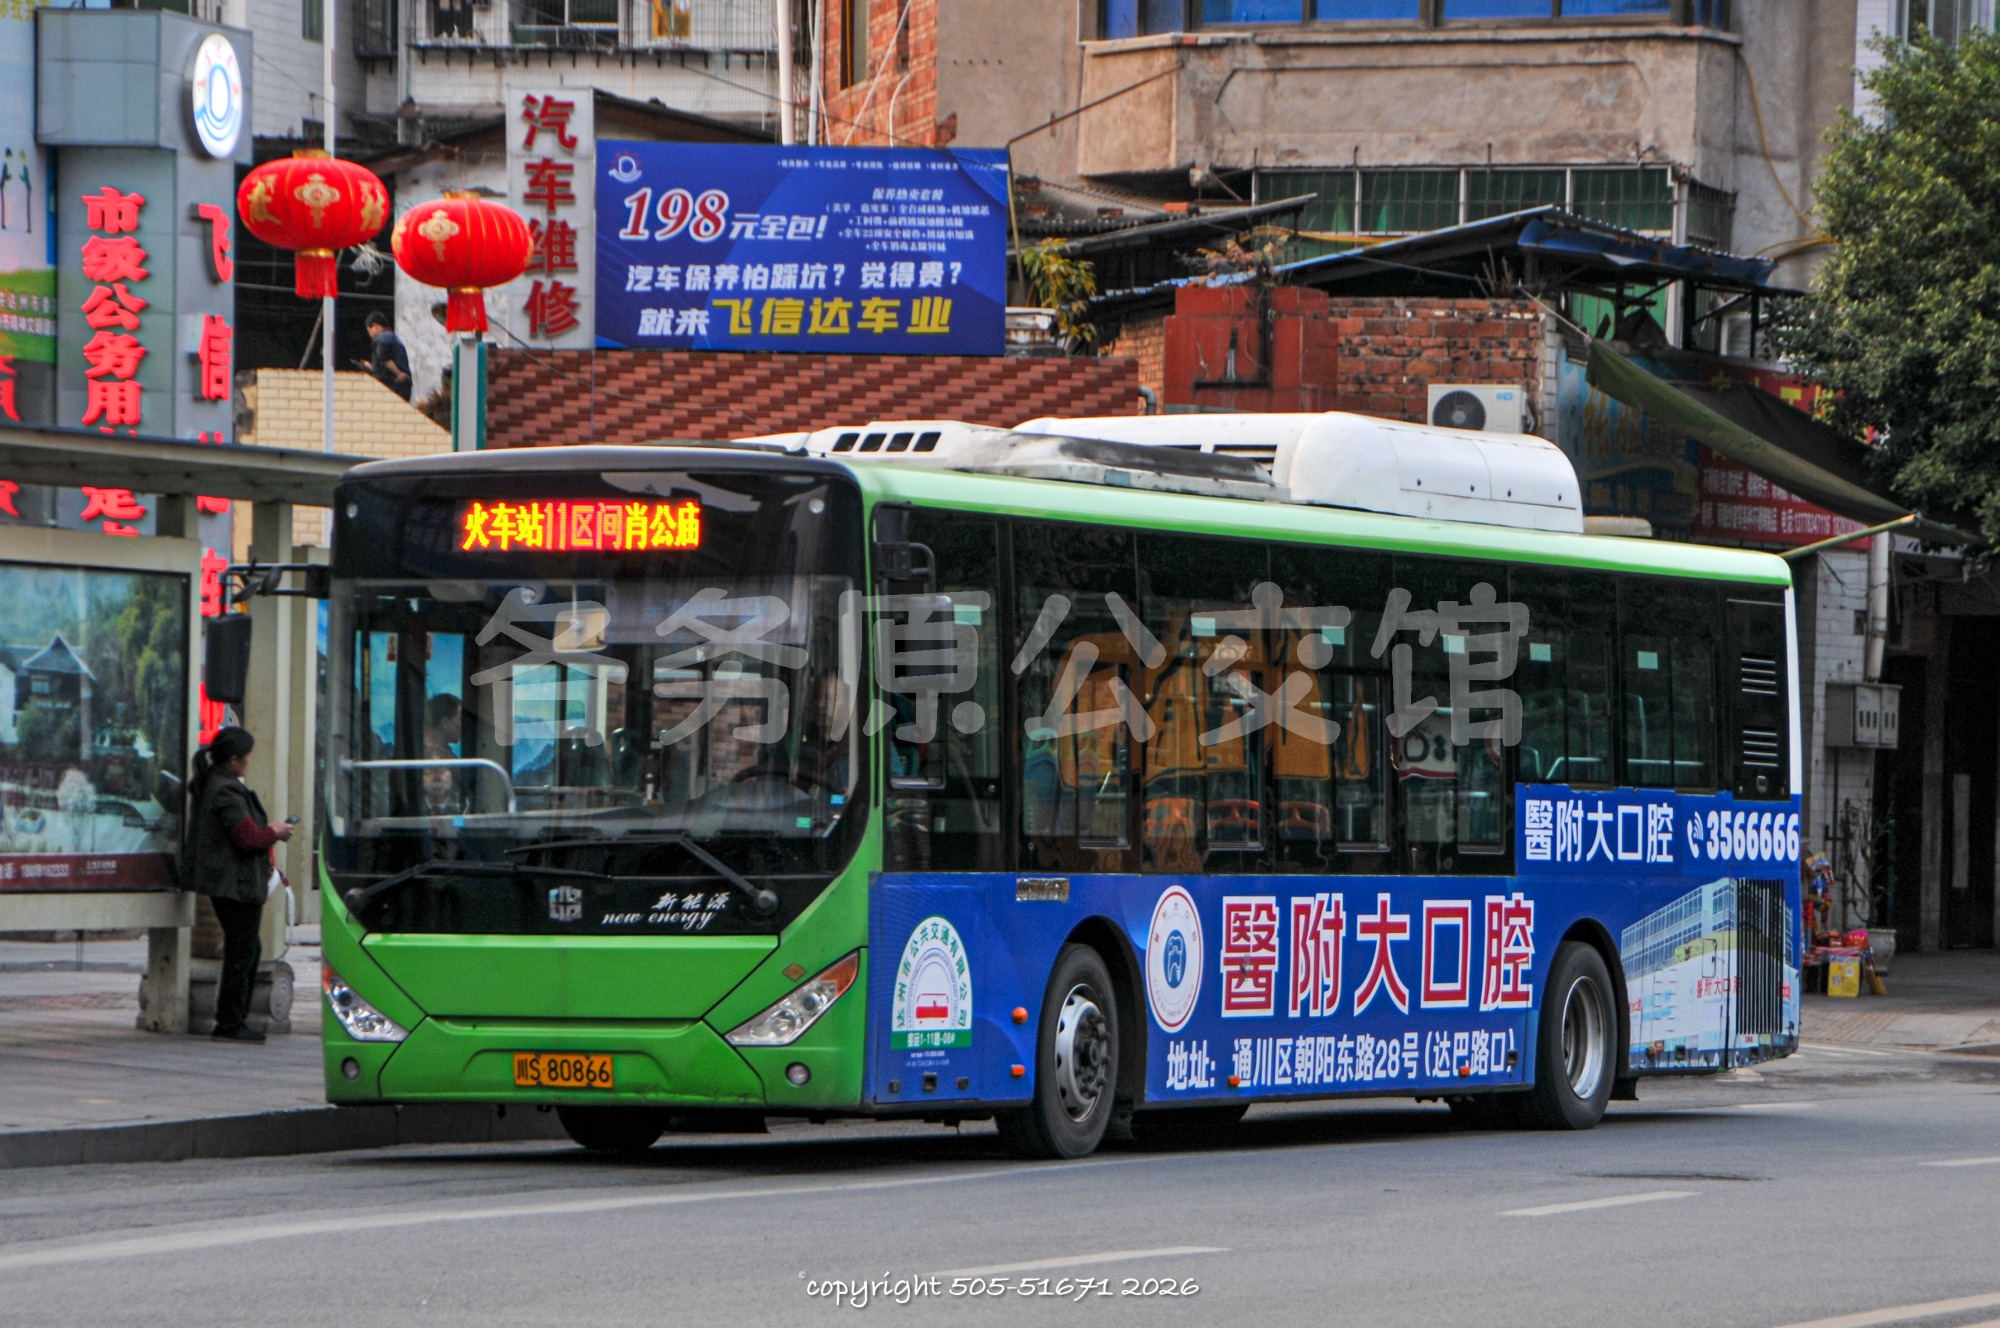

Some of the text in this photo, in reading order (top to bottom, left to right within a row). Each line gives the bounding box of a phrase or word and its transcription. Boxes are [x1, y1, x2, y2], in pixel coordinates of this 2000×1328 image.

[522, 93, 581, 337] 汽车维修
[637, 297, 953, 337] 就来飞信达车业
[1706, 810, 1800, 862] 3566666
[601, 910, 717, 931] new energy
[651, 891, 730, 911] 新能源
